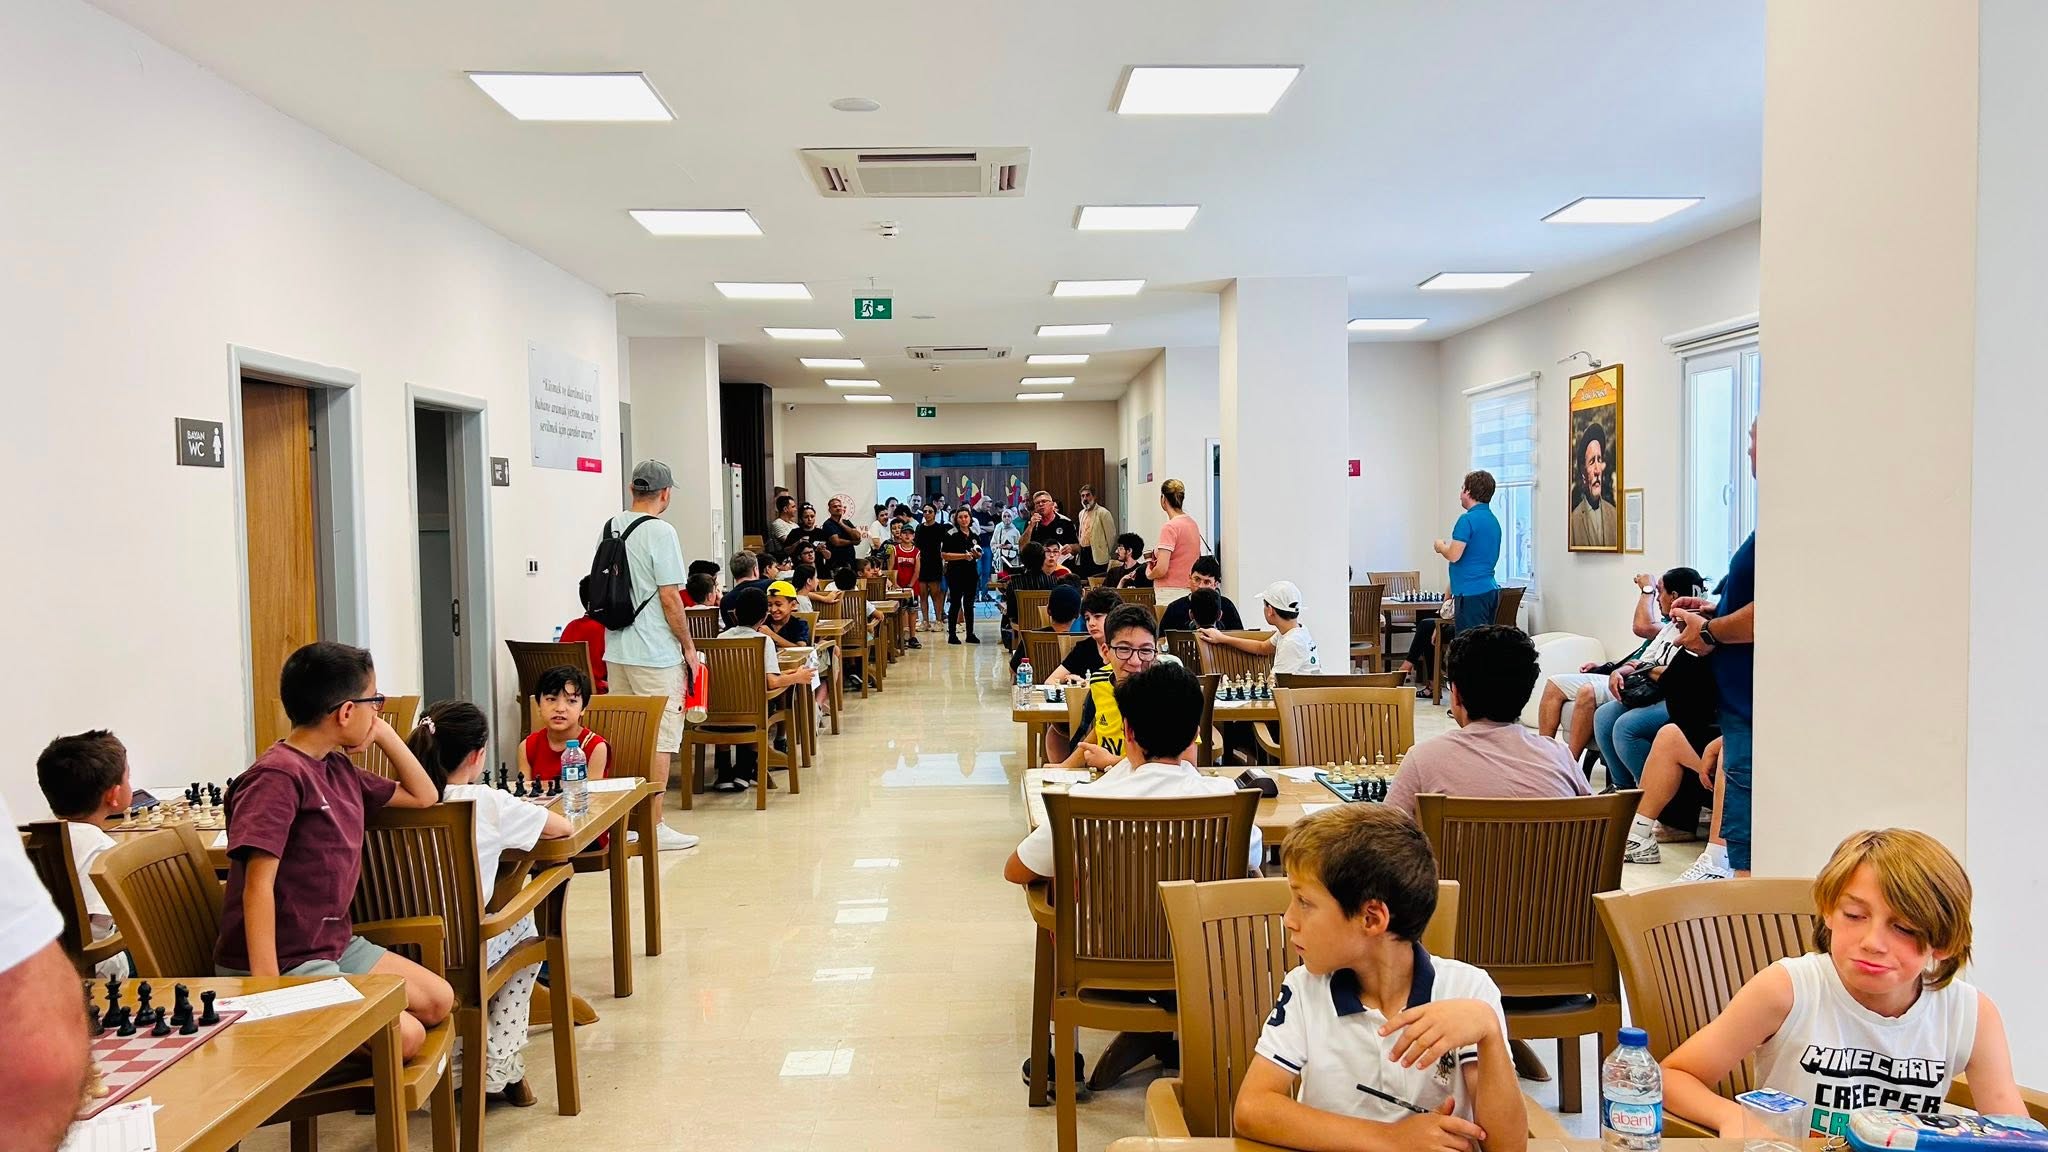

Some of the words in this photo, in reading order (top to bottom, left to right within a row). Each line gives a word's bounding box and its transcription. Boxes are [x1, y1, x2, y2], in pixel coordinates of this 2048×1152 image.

[187, 430, 205, 440] BAYAN
[188, 441, 205, 457] WC
[1101, 736, 1122, 756] AV
[1800, 1045, 1946, 1088] MINECRAF
[1814, 1083, 1941, 1114] CREEPER
[1612, 1111, 1652, 1126] abant
